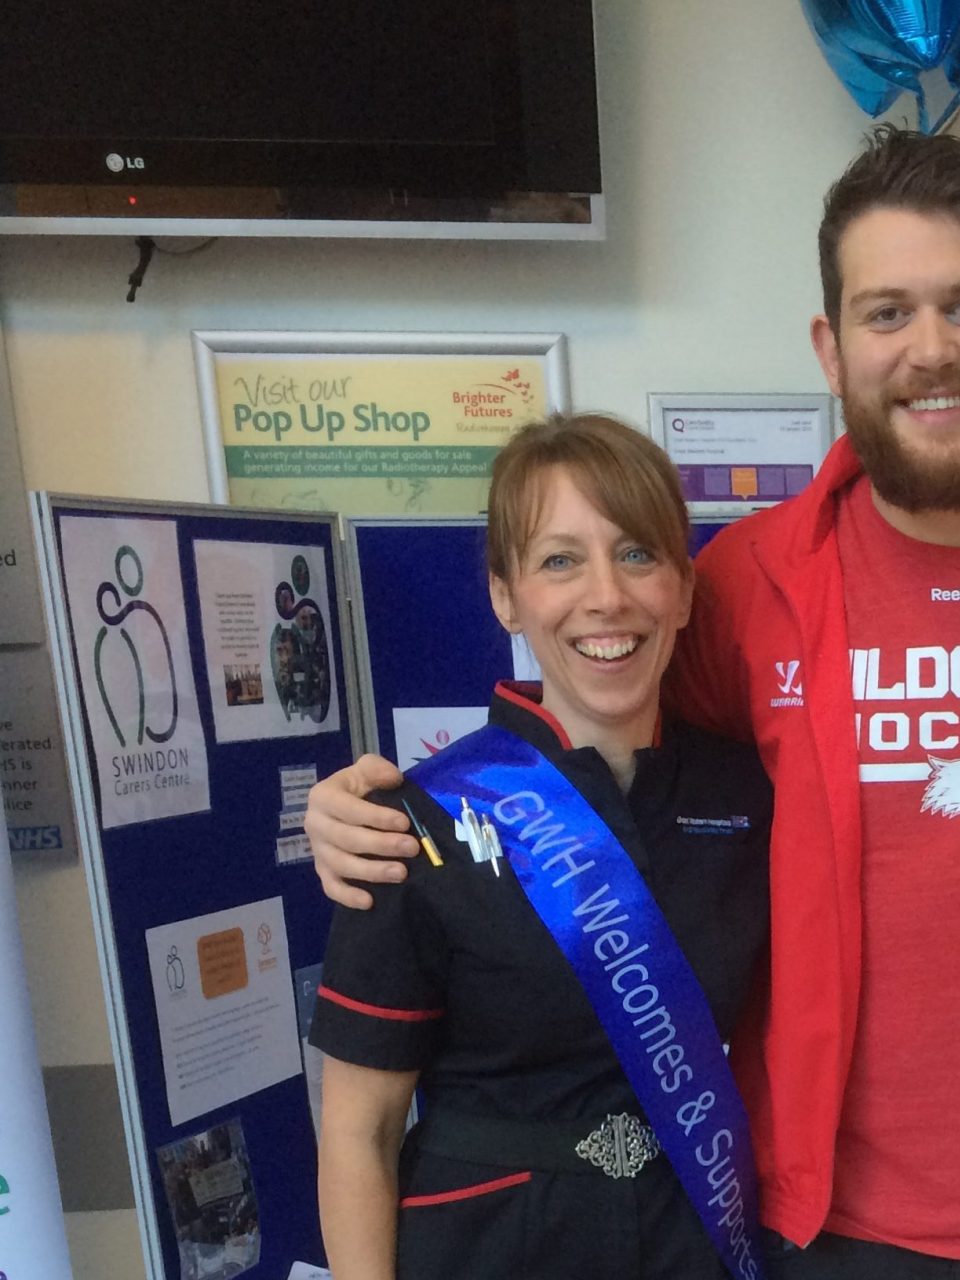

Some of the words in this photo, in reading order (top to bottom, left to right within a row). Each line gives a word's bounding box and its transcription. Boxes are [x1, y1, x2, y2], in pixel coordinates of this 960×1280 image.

[126, 157, 145, 169] LG
[234, 375, 300, 408] Visit
[309, 376, 352, 403] our
[452, 391, 506, 407] Brighter
[464, 406, 513, 417] Futures
[233, 403, 292, 441] Pop
[300, 404, 346, 441] Up
[353, 403, 431, 441] Shop
[253, 451, 288, 462] variety
[291, 450, 302, 460] of
[306, 450, 352, 460] beautiful
[355, 450, 377, 462] gifts
[380, 450, 399, 460] and
[403, 450, 432, 462] goods
[435, 450, 450, 460] for
[453, 450, 471, 460] sale
[244, 463, 300, 475] generating
[305, 463, 341, 473] income
[361, 464, 379, 473] our
[382, 463, 449, 475] Radiotherapy
[112, 748, 189, 778] SWINDON
[114, 780, 151, 796] Carers
[493, 789, 596, 887] GWH
[572, 882, 693, 1094] Welcomes
[676, 1090, 716, 1136] &
